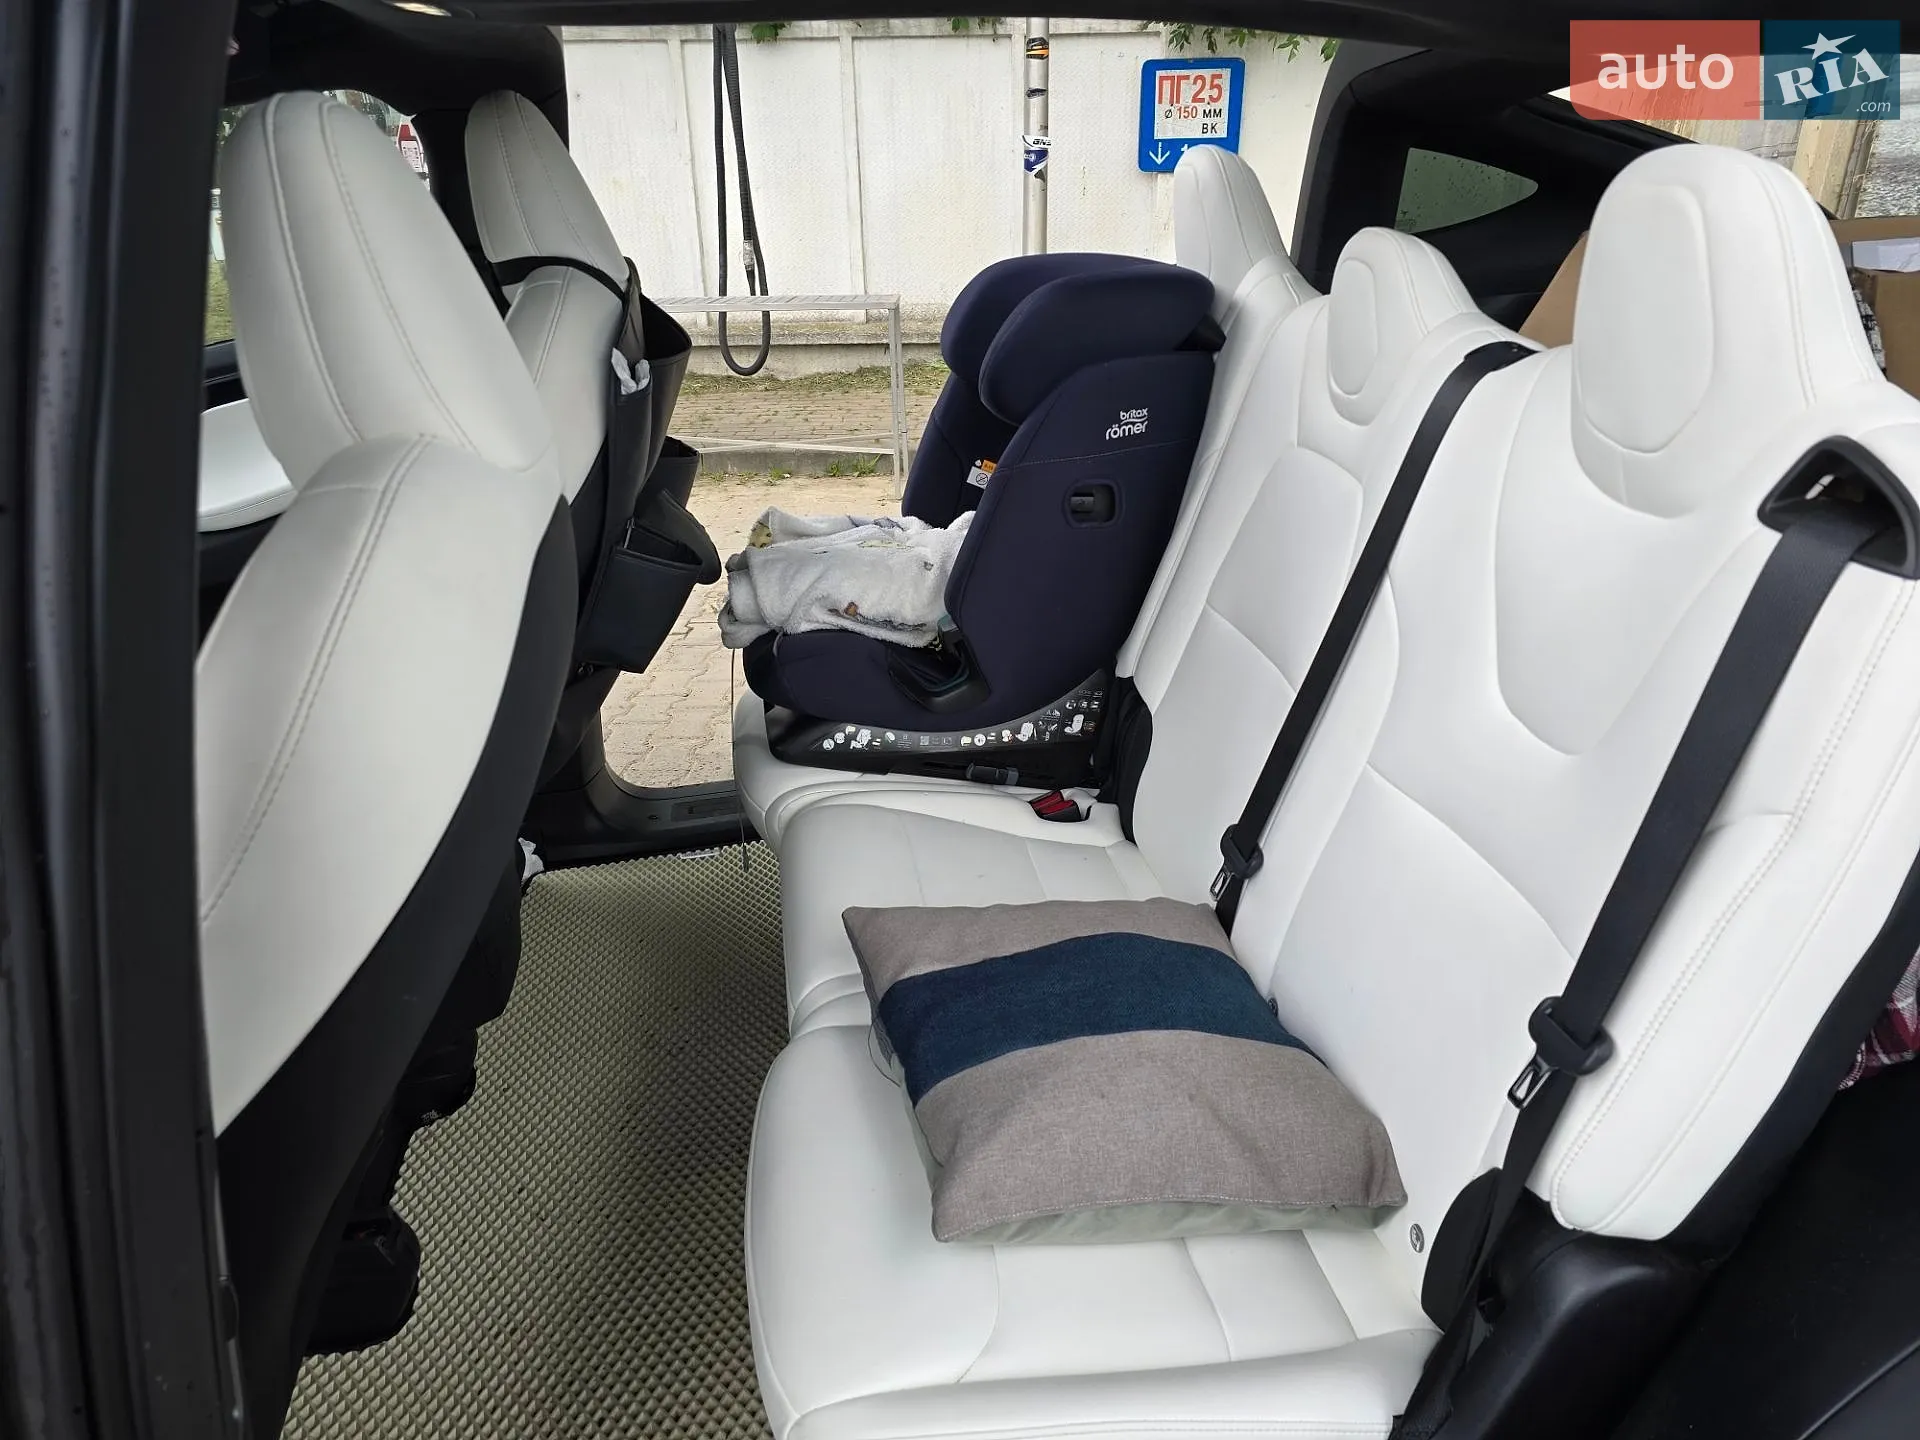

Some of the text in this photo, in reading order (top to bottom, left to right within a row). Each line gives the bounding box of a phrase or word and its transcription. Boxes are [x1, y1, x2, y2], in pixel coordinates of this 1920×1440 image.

[1177, 106, 1198, 119] 150
[1120, 407, 1148, 420] britax
[1105, 420, 1148, 441] römer
